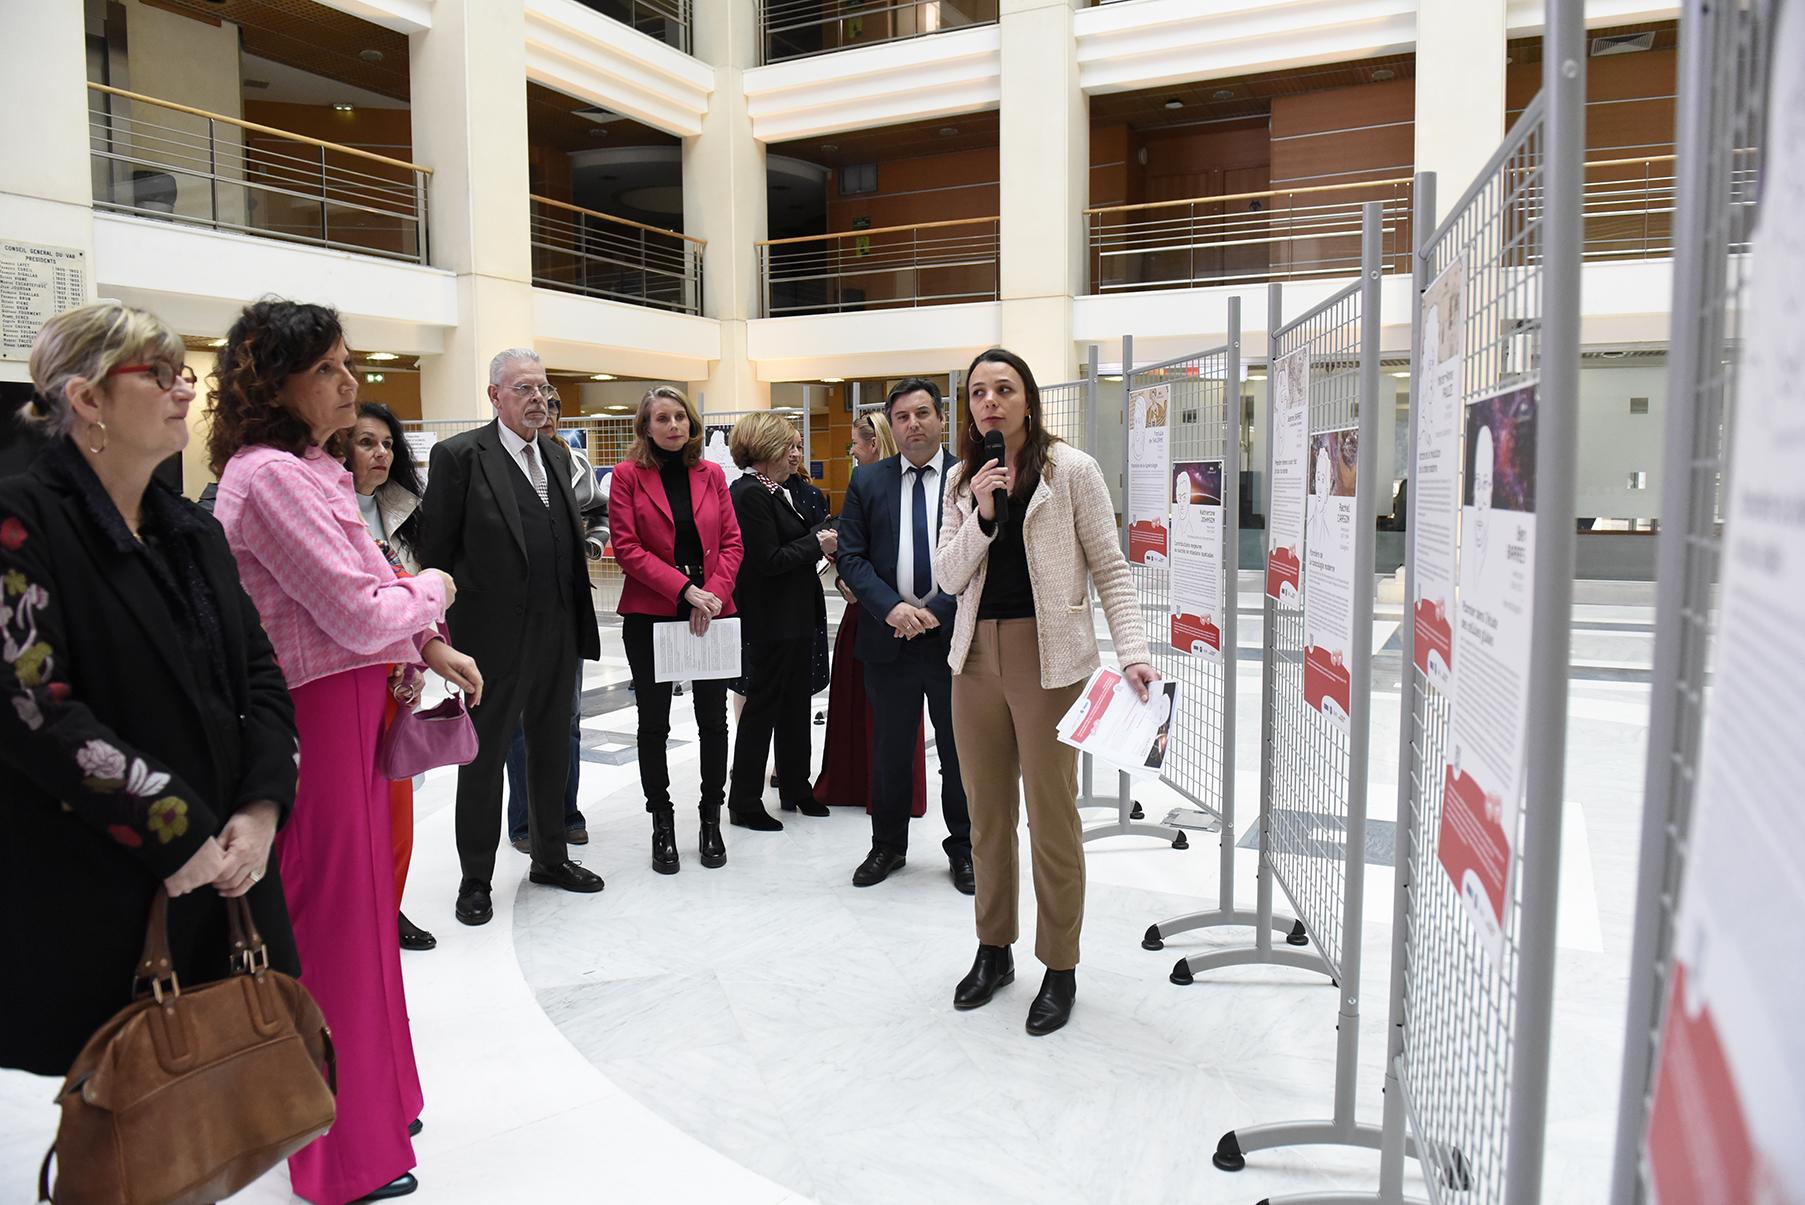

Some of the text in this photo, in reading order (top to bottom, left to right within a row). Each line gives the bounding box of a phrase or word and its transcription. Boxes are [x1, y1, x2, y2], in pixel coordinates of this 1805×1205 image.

[4, 244, 26, 254] CONSEIL
[30, 248, 52, 256] GENERAL
[26, 256, 56, 264] PRESIDENTS
